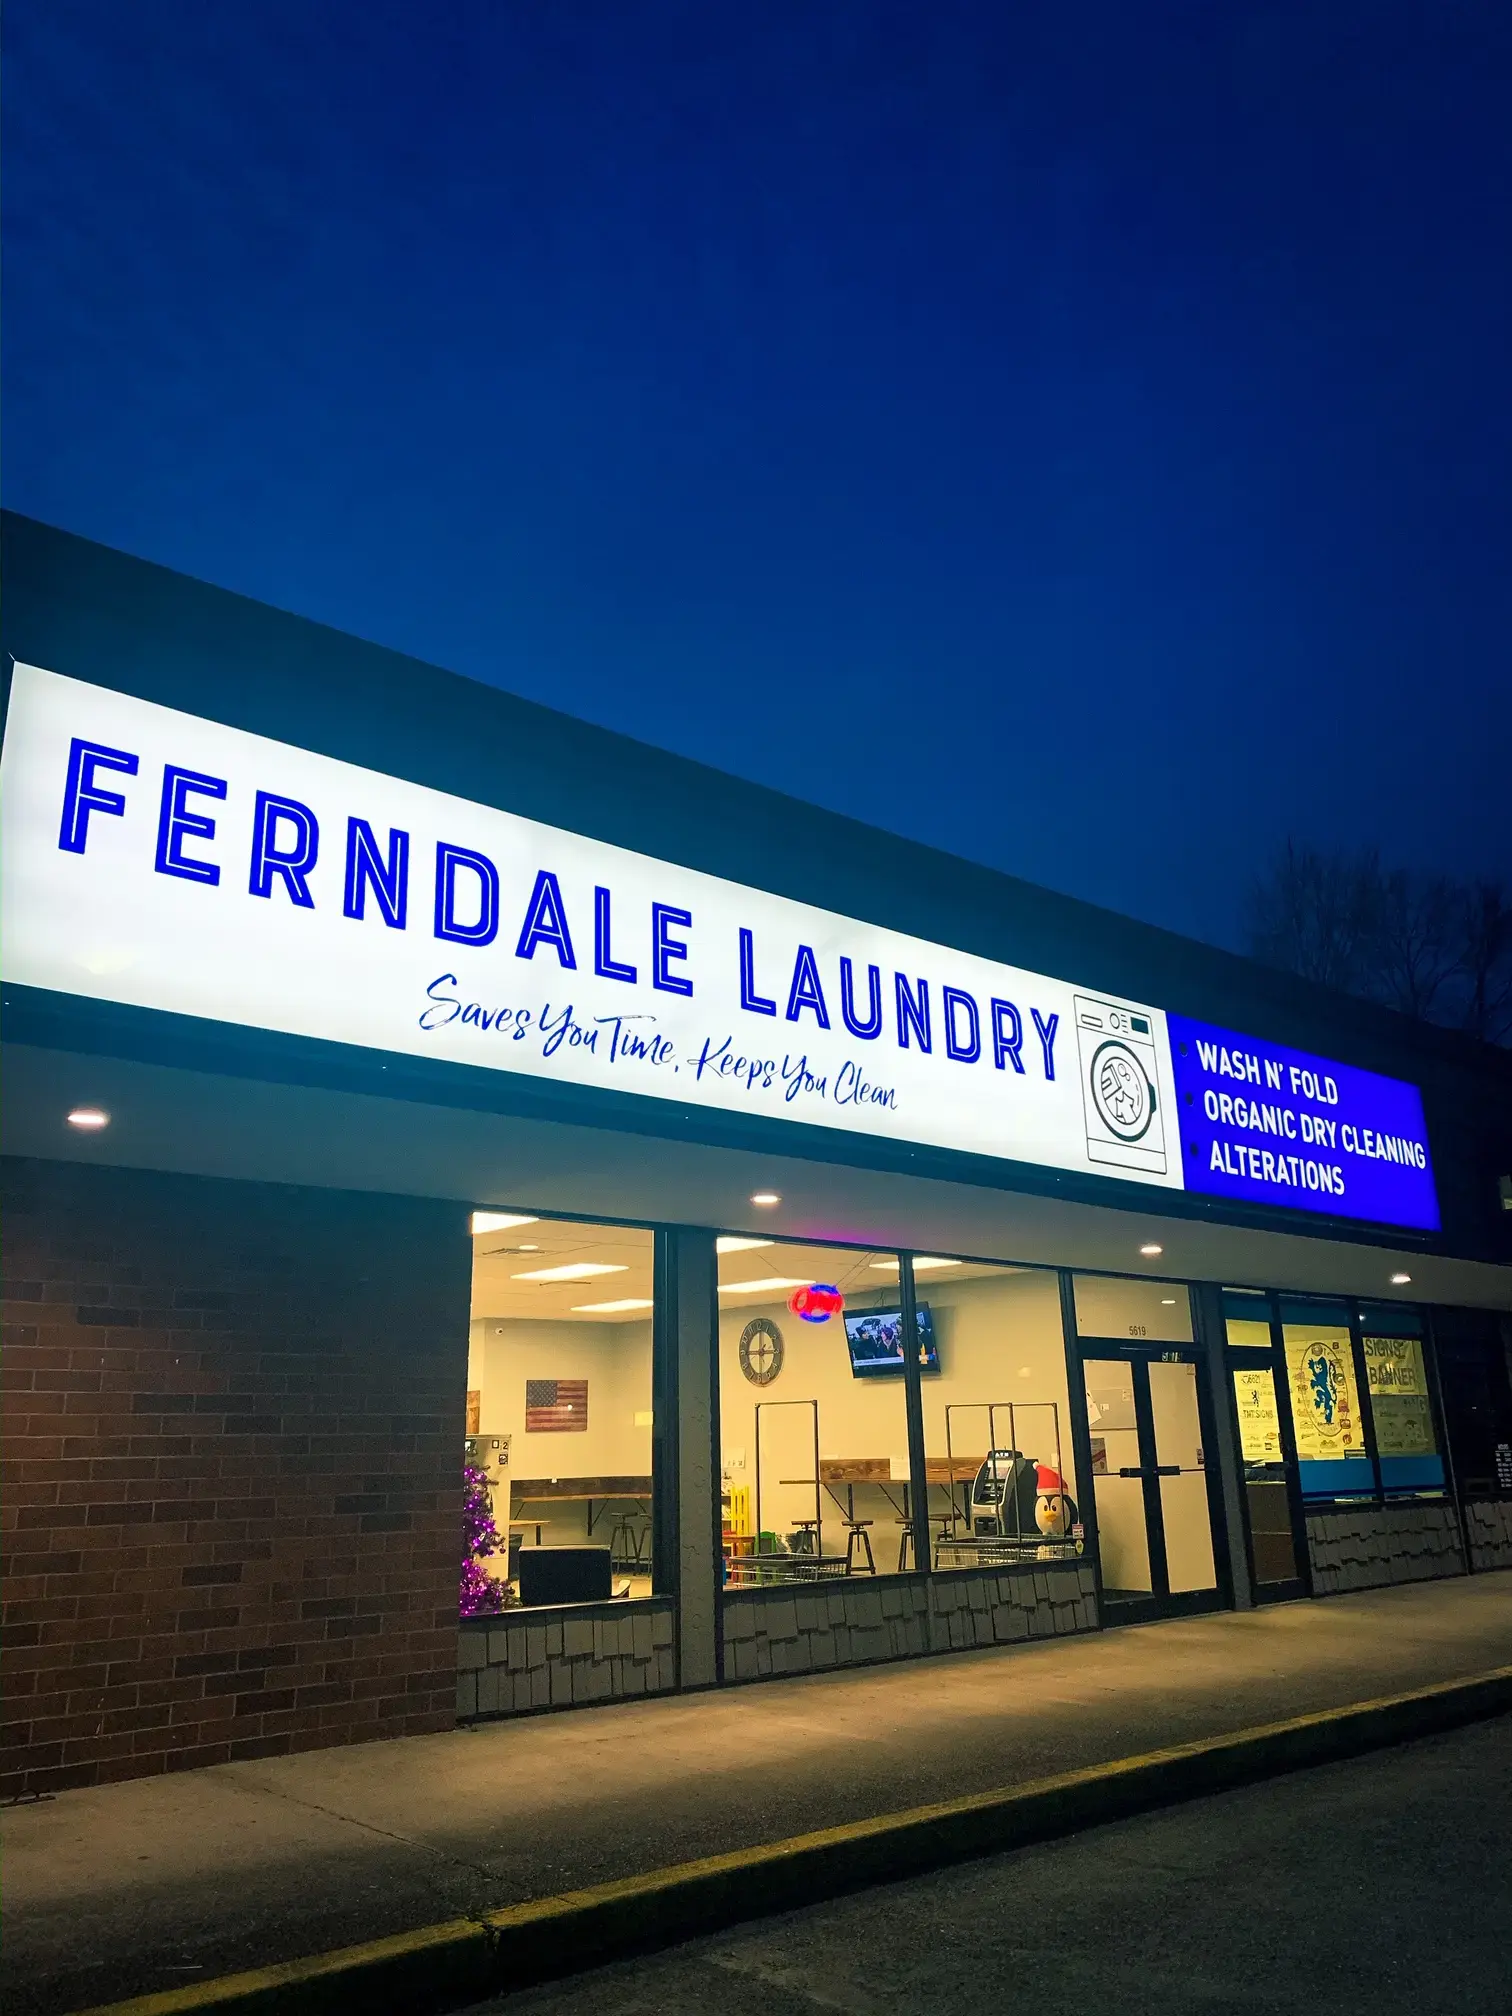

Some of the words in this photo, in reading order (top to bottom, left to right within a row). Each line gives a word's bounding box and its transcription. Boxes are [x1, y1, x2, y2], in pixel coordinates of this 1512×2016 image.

[58, 737, 693, 997] FERNDALE
[739, 928, 1059, 1081] LAUNDRY
[418, 973, 535, 1041] Saves
[538, 1003, 599, 1058] You
[593, 1016, 679, 1073] Time,
[687, 1035, 775, 1090] Keeps
[781, 1054, 827, 1103] You
[834, 1060, 898, 1111] Clean
[1196, 1039, 1261, 1085] WASH
[1265, 1059, 1284, 1091] N'
[1289, 1066, 1339, 1105] FOLD
[1204, 1089, 1297, 1140] ORGANIC
[1299, 1113, 1337, 1149] DRY
[1341, 1124, 1426, 1170] CLEANING
[1209, 1140, 1345, 1196] ALTERATIONS
[1129, 1326, 1146, 1336] 5619
